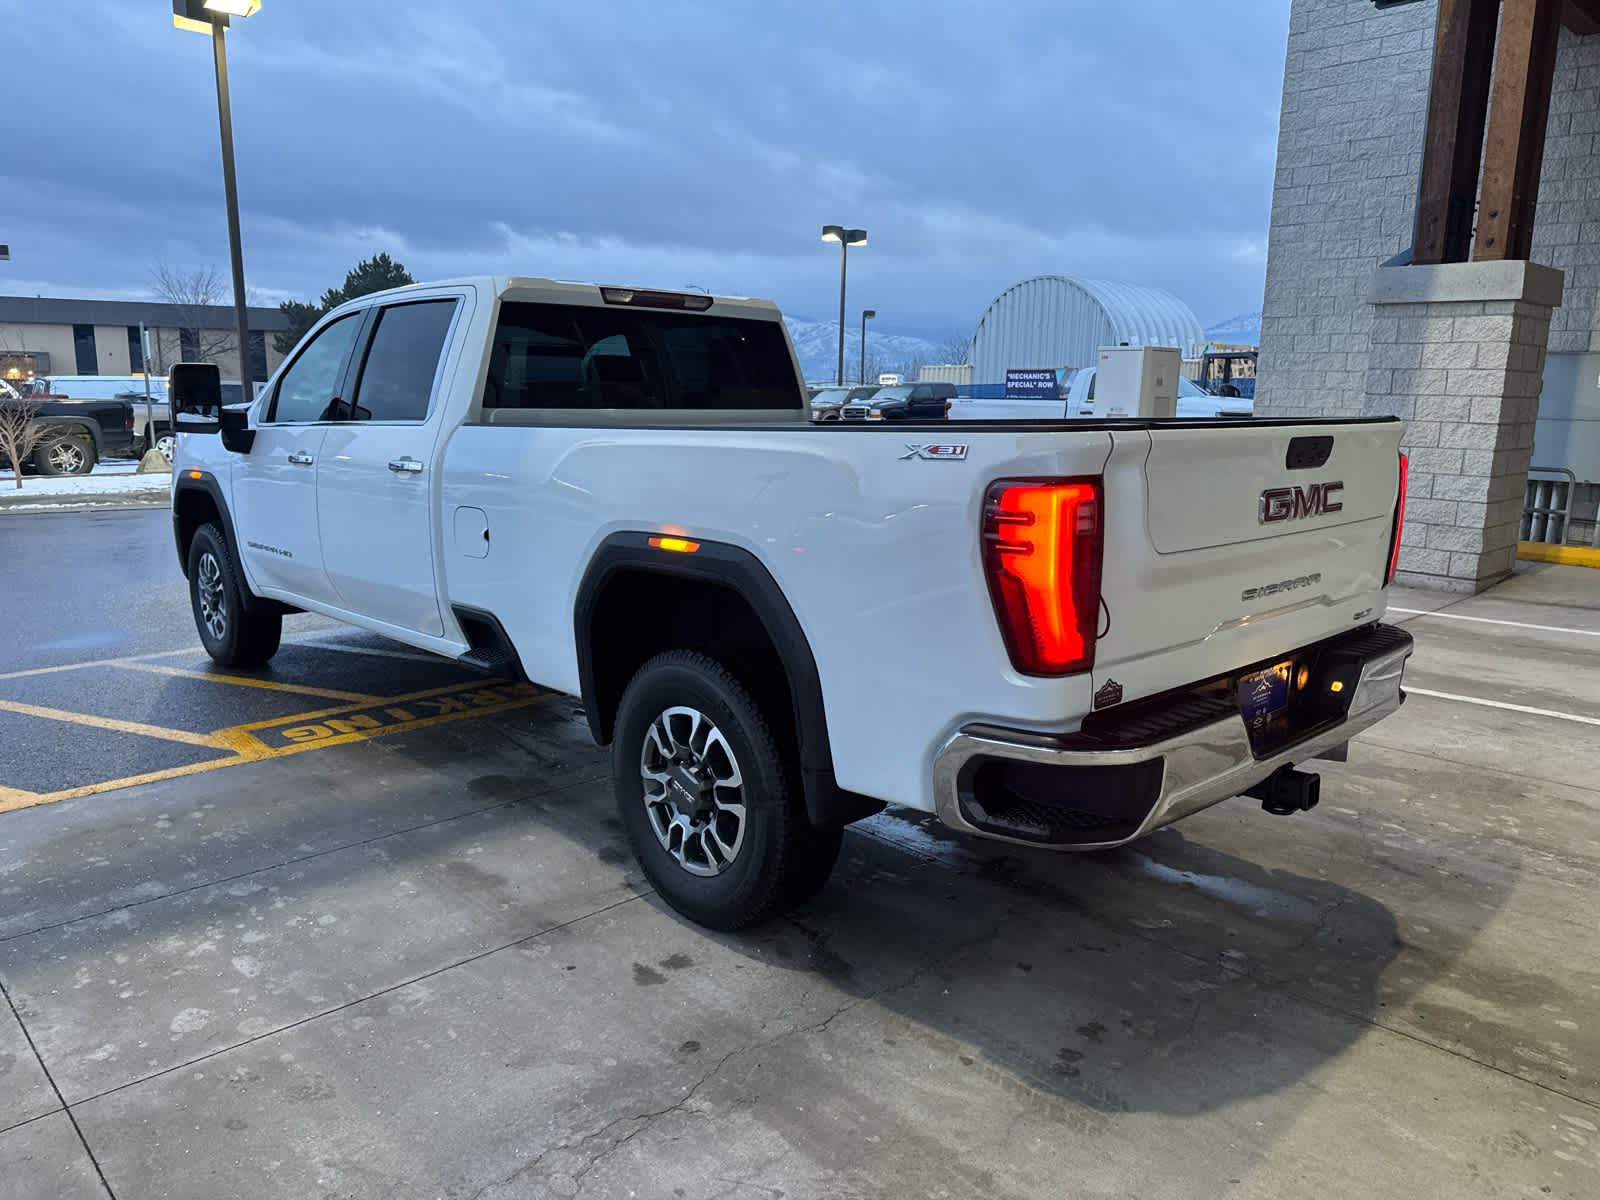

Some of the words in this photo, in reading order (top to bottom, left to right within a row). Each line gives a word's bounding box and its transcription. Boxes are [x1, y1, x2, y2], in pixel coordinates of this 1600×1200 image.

[898, 444, 968, 460] X31
[1258, 480, 1345, 525] GMC
[1241, 573, 1322, 602] SIERRA
